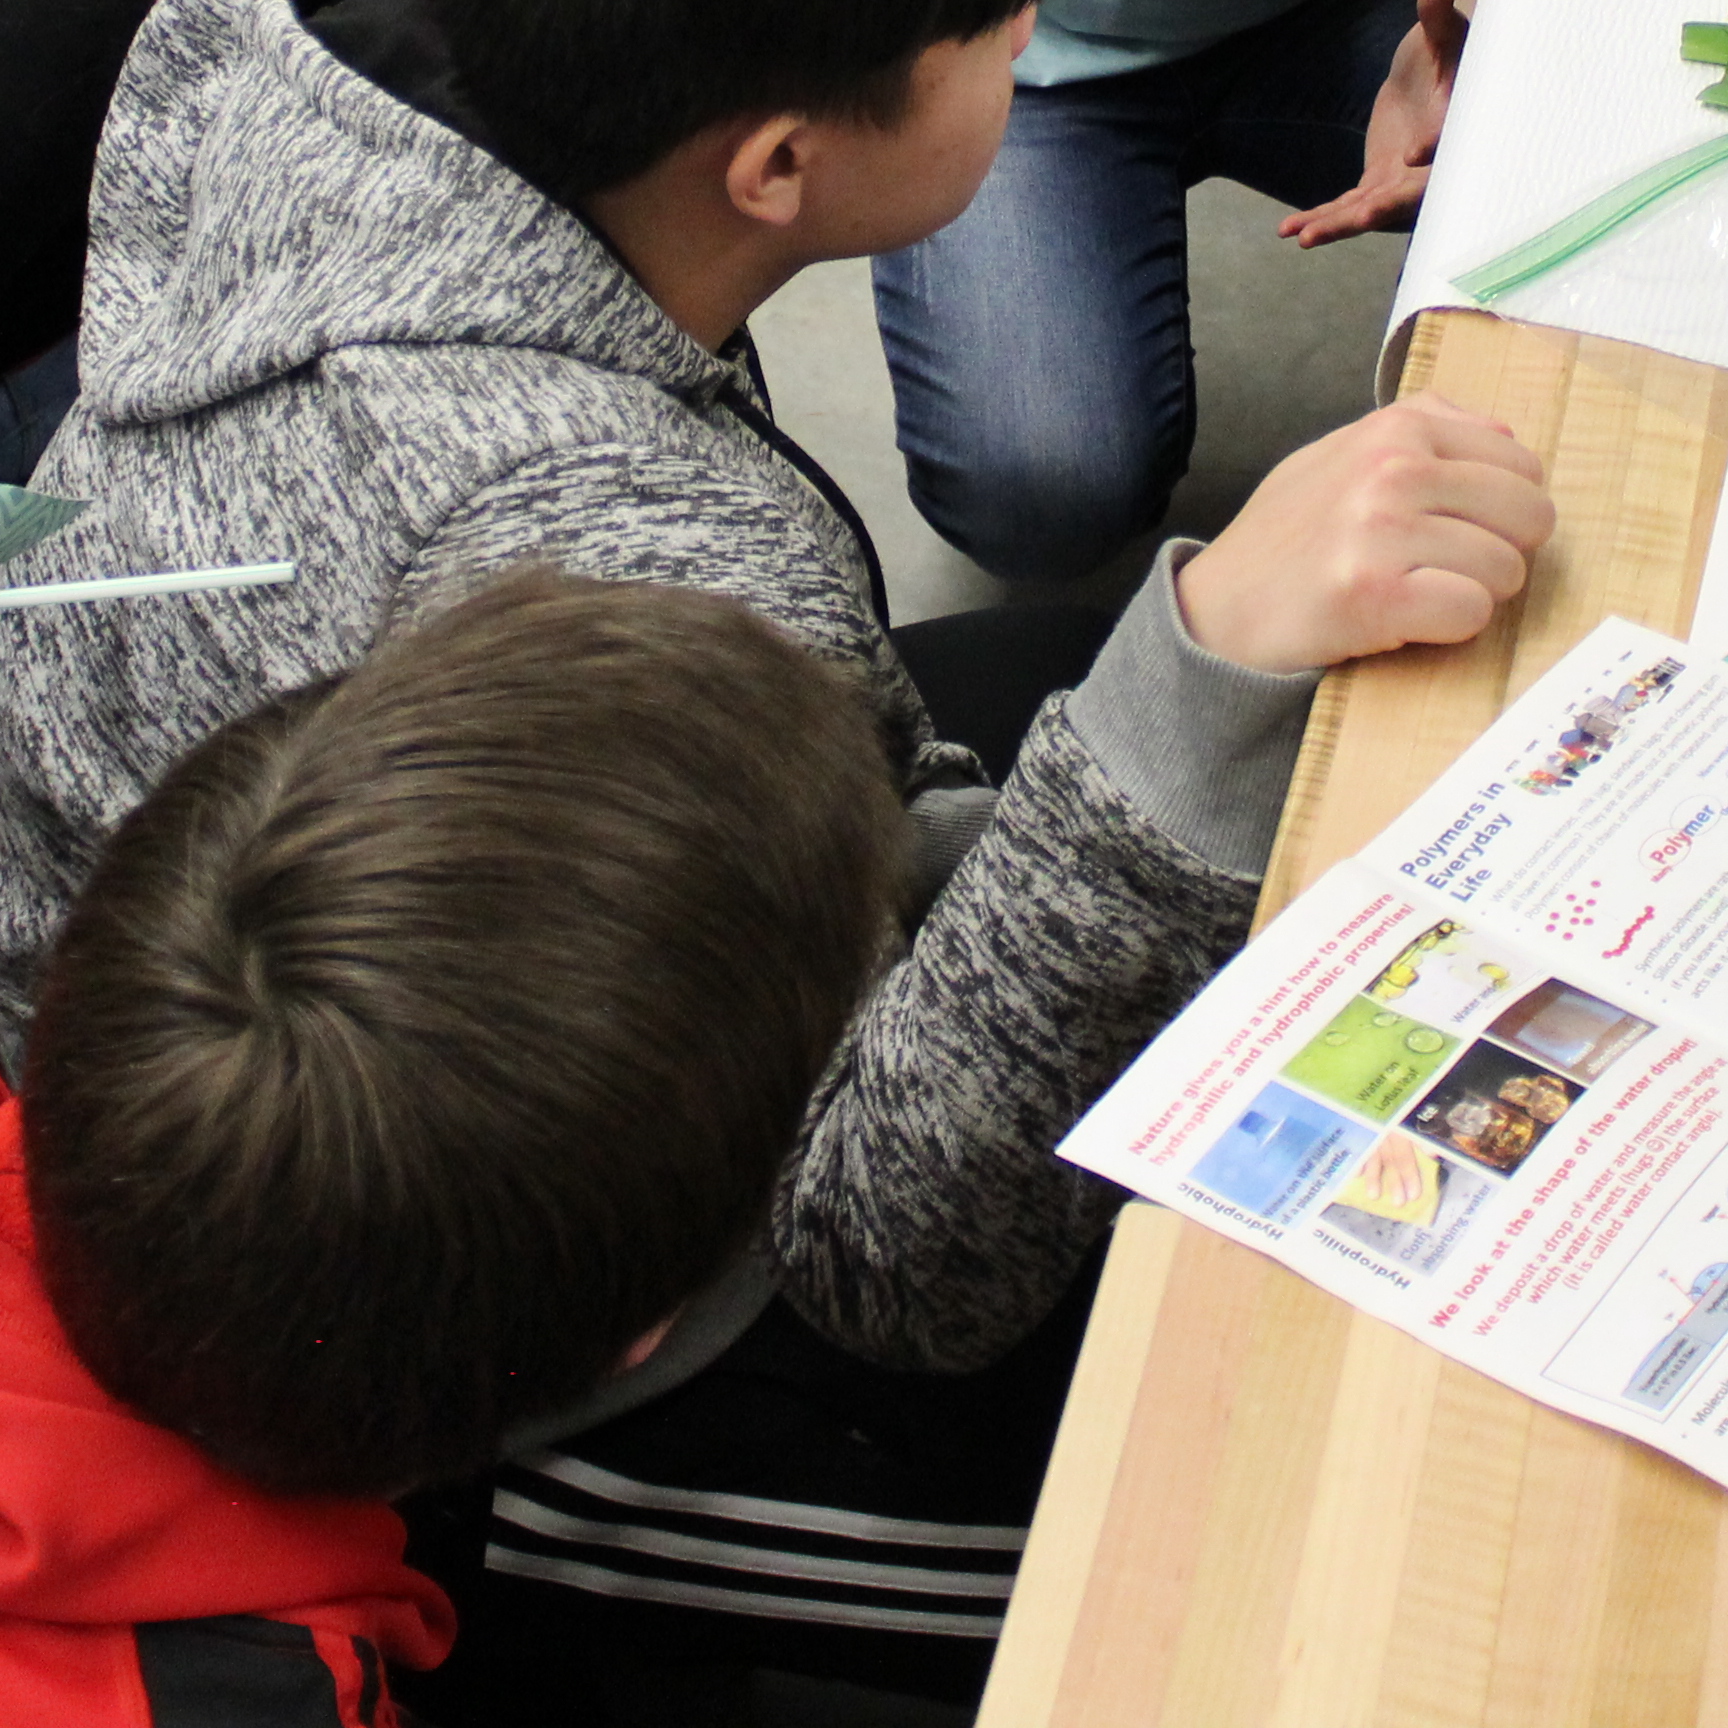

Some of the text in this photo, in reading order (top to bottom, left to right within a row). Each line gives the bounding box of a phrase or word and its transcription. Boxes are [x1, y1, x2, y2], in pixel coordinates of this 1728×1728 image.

[1399, 781, 1505, 878] Polymers in
[1425, 814, 1514, 889] Everyday
[1649, 805, 1716, 864] Polymer
[1449, 868, 1492, 902] Life
[1128, 893, 1393, 1154] Nature gives you a hint how to measure
[1148, 902, 1415, 1164] hydrophilic and hydrophobic properties!
[1670, 1085, 1693, 1101] the
[1633, 1101, 1677, 1144] measure
[1614, 1144, 1636, 1166] and
[1428, 1037, 1697, 1328] We look at the shape of the water droplet!
[1528, 1265, 1563, 1304] which
[1559, 1228, 1594, 1264] water
[1591, 1186, 1627, 1224] meets
[1663, 1118, 1687, 1136] the
[1684, 1086, 1719, 1118] surface
[1583, 1169, 1616, 1203] water
[1178, 1182, 1284, 1241] Hydrophobic
[1571, 1203, 1586, 1218] of
[1313, 1227, 1410, 1291] Hydrophilic
[1536, 1253, 1548, 1261] a
[1541, 1220, 1577, 1251] drop
[1493, 1262, 1540, 1311] deposit
[1473, 1315, 1499, 1337] We
